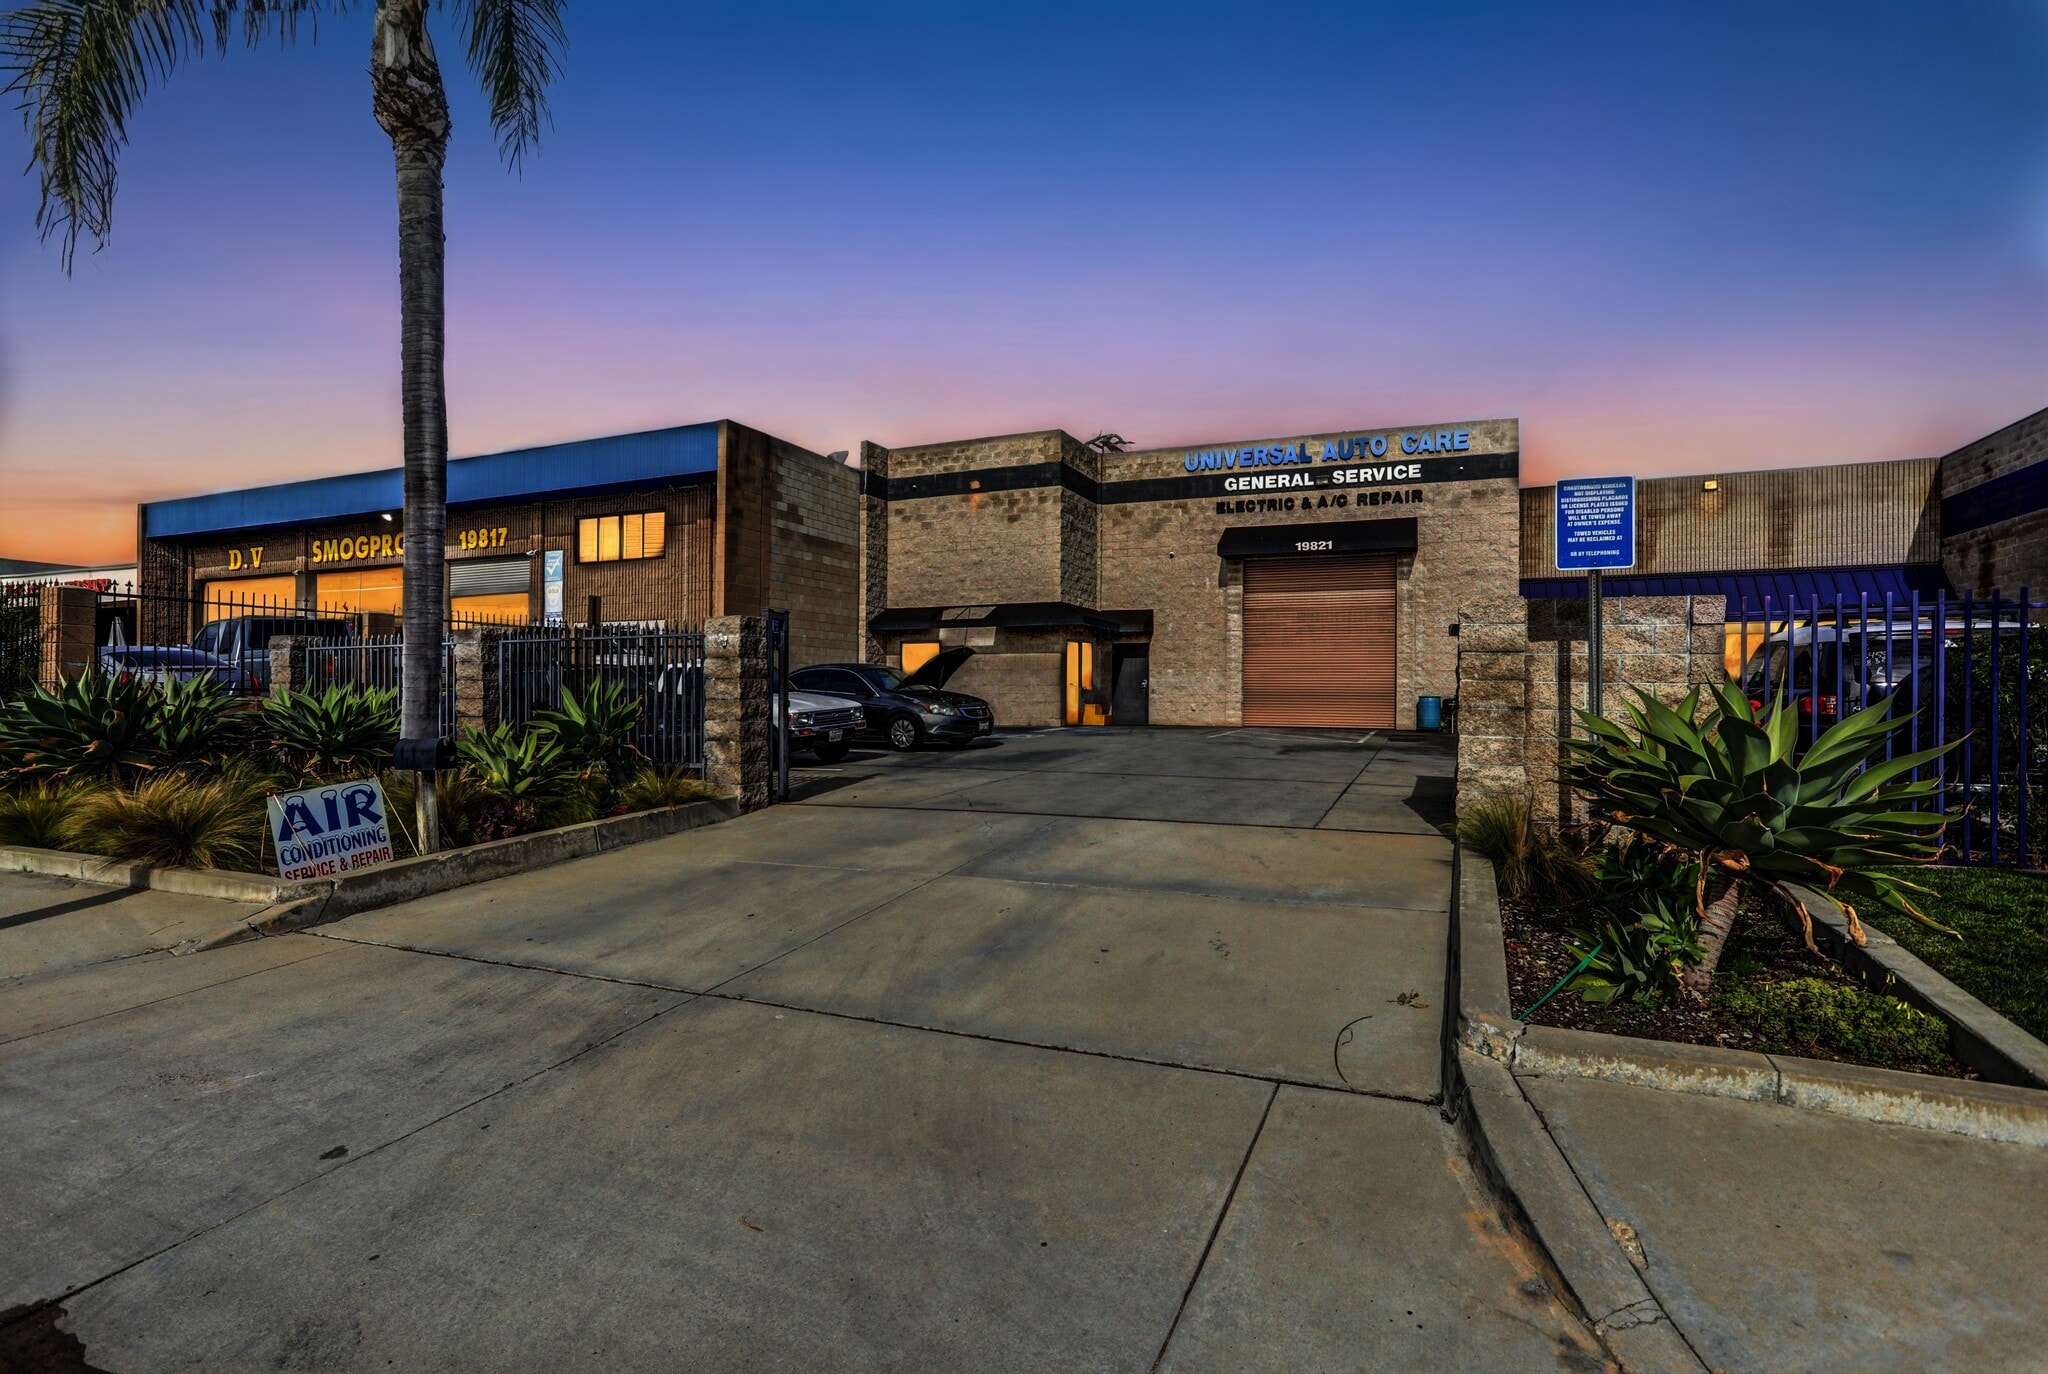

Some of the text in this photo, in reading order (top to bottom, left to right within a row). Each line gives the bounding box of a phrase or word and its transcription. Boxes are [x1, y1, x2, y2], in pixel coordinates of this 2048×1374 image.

[1184, 429, 1470, 472] UNIVERSAL AUTO CARE
[1224, 463, 1422, 492] GENERAL SERVICE
[1216, 489, 1424, 515] ELECTRIC & A/C REPAIR
[459, 527, 508, 551] 19817
[1295, 540, 1333, 551] 19821
[1585, 549, 1620, 557] TELEPHONING
[278, 783, 383, 842] AIR
[280, 824, 387, 867] CONDITIONING
[284, 846, 391, 881] SERVICE & REPAIR
